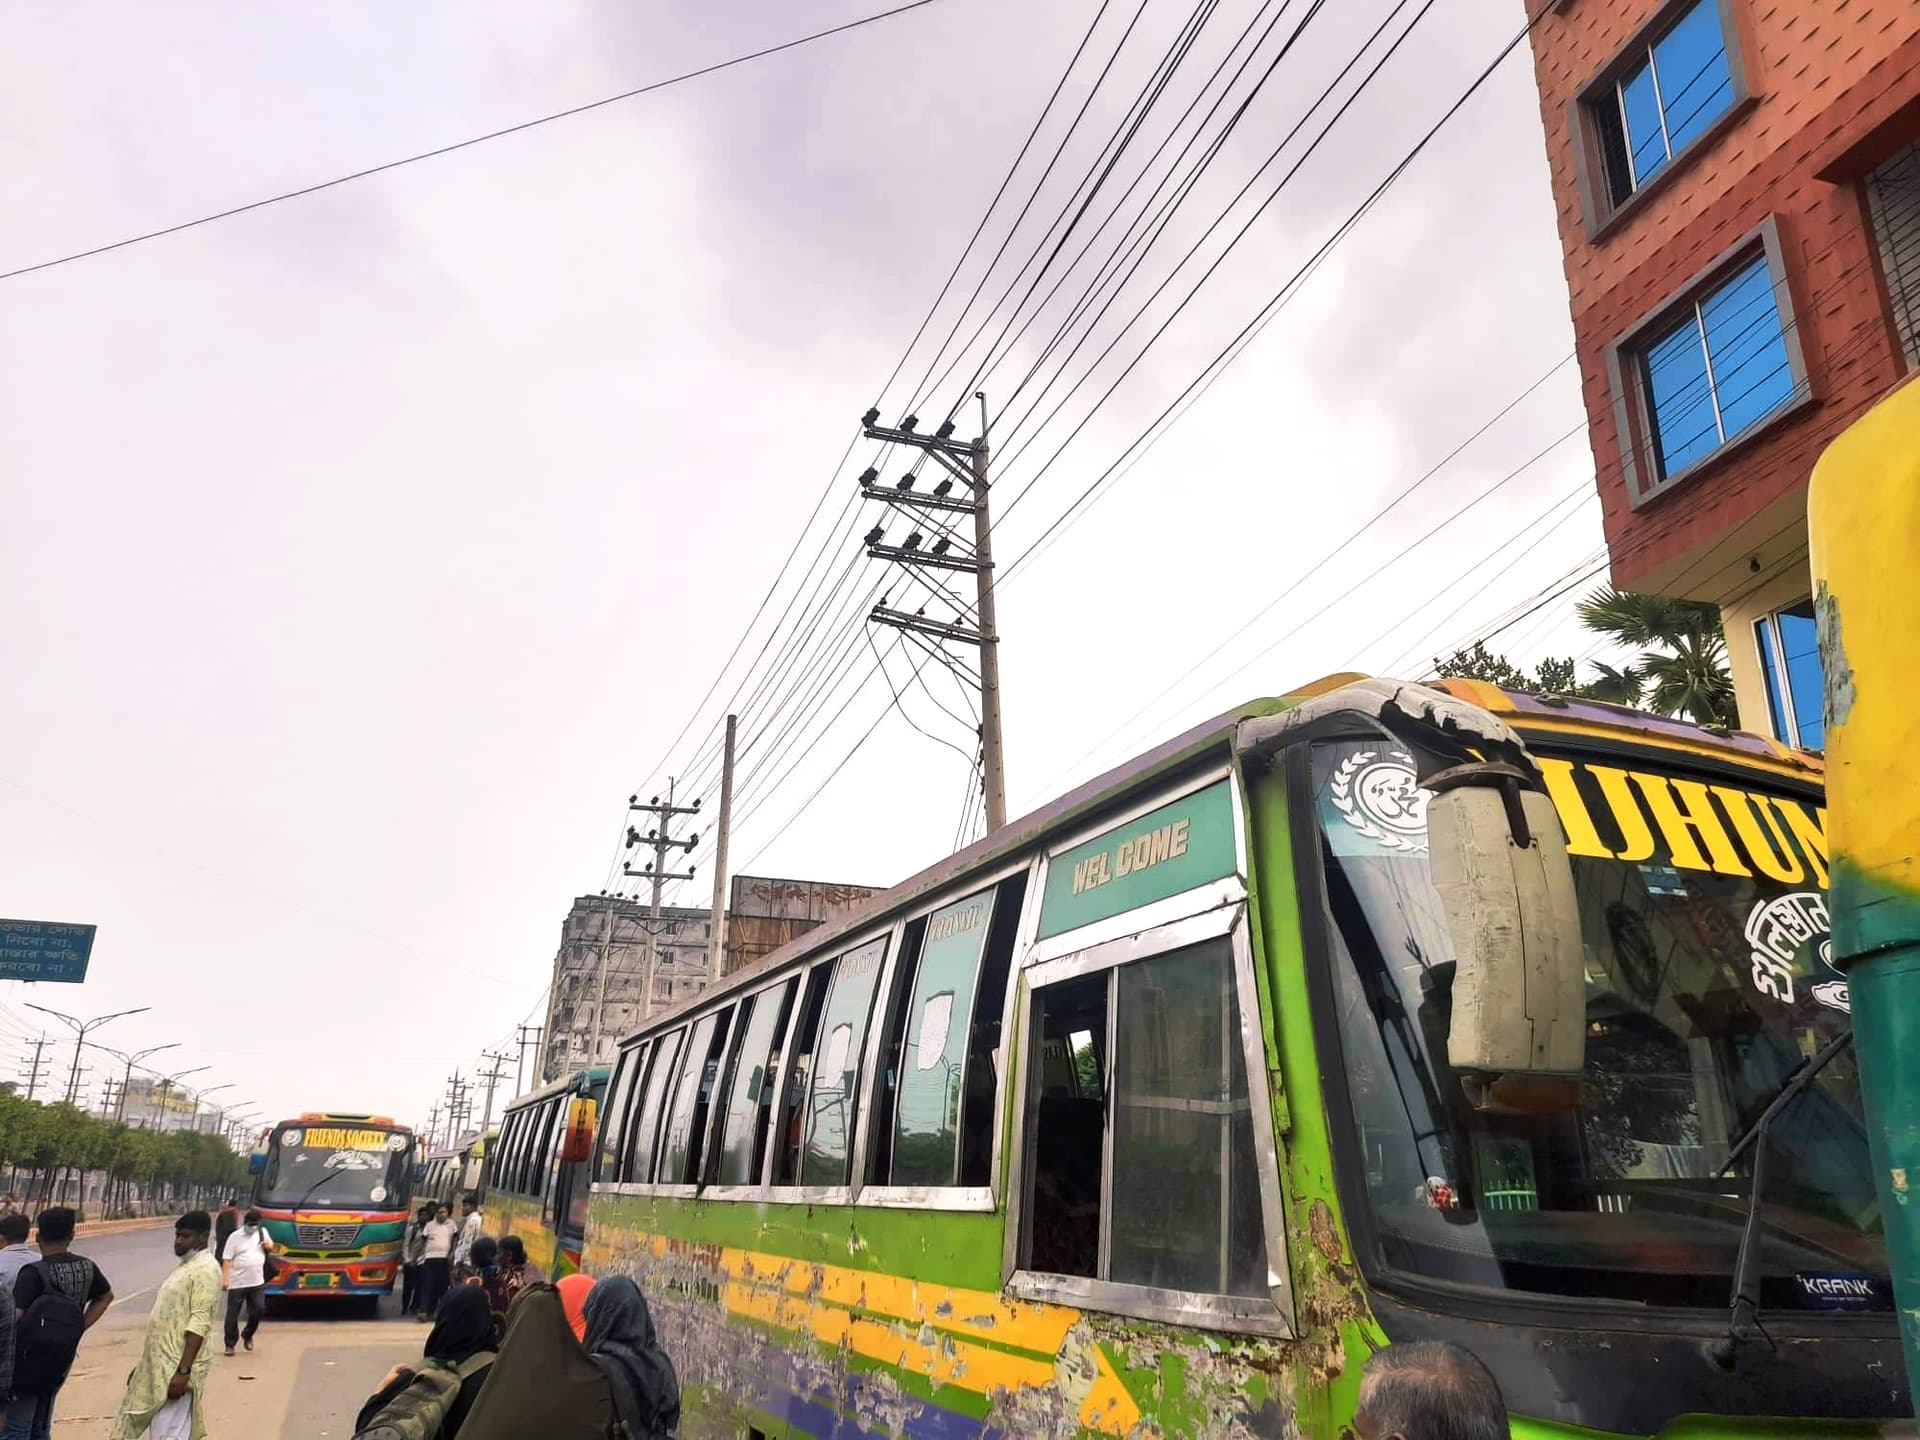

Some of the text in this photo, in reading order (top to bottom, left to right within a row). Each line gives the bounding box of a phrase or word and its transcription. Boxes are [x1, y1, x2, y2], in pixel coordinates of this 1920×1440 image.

[1465, 748, 1829, 890] IJHU
[1115, 816, 1190, 878] COME
[304, 1128, 346, 1149] FRIENDS
[1803, 1278, 1874, 1295] KRANK
